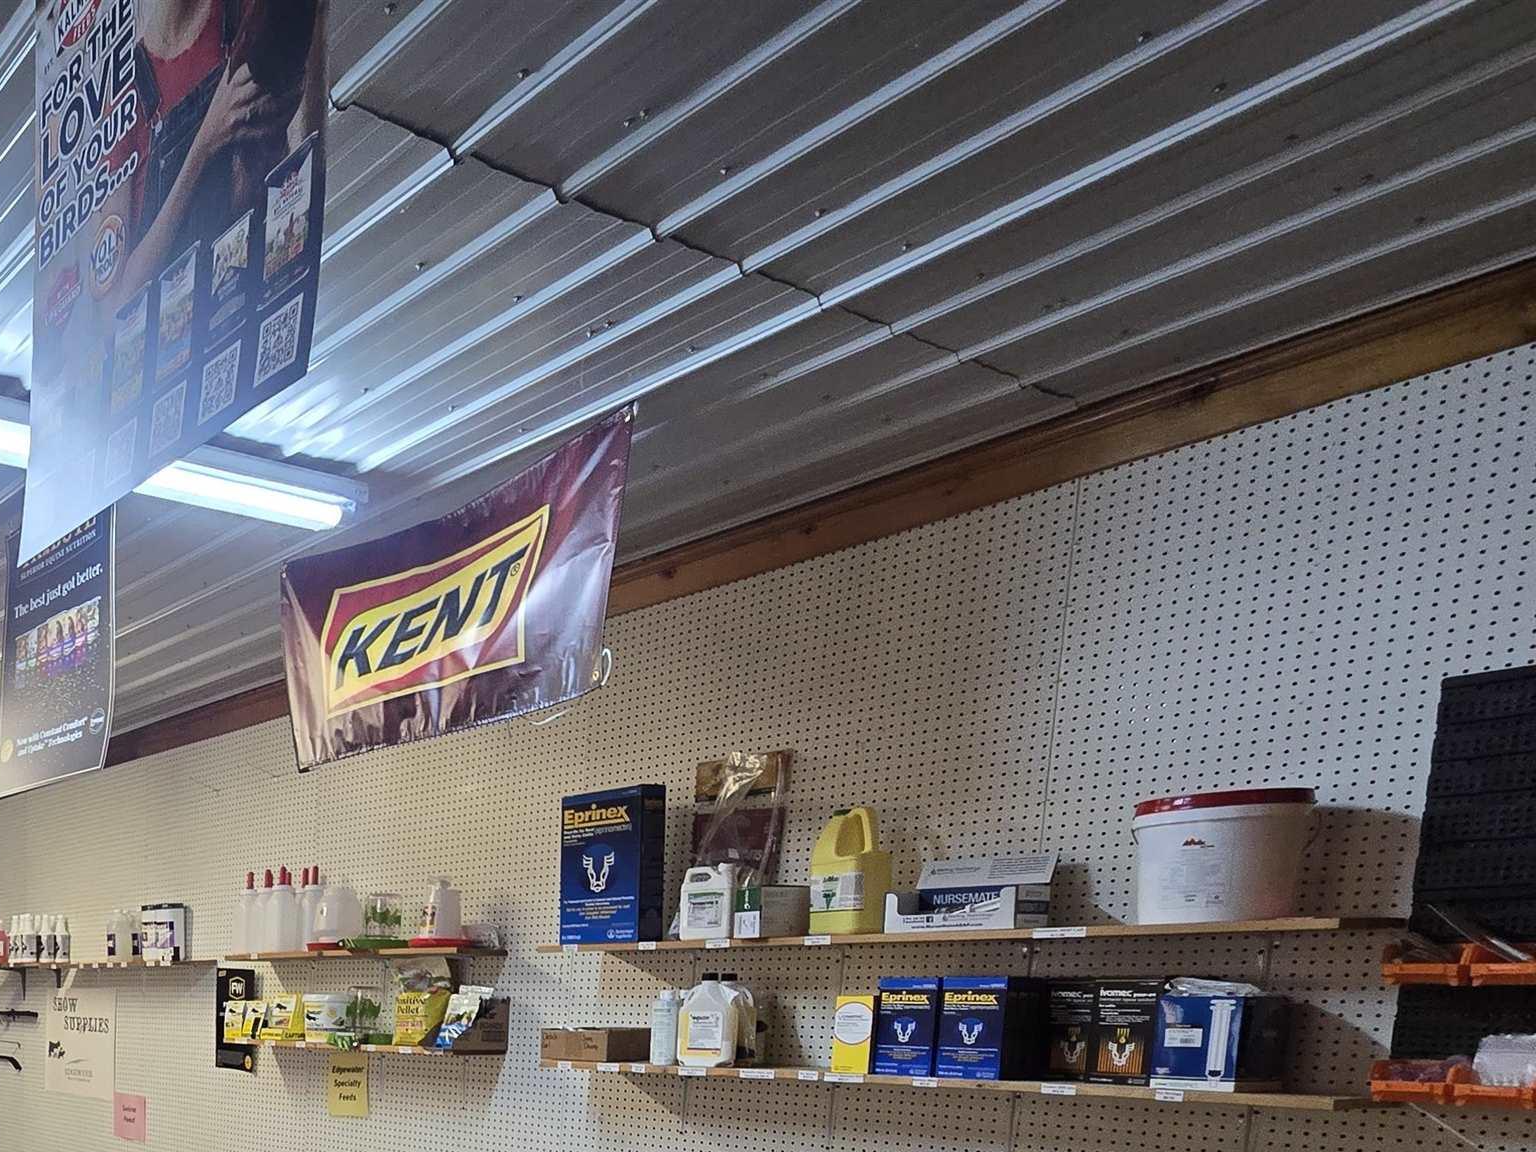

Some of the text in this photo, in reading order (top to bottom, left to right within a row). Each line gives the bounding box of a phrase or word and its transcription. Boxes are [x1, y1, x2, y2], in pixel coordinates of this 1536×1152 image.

[41, 0, 134, 133] FOR THE
[40, 20, 136, 188] LOVE
[39, 168, 68, 226] OF
[71, 89, 137, 189] YOUR
[14, 563, 103, 618] The best just got better.
[335, 542, 531, 690] KENT
[564, 803, 630, 826] Eprinex
[932, 890, 999, 906] NURSEMATE
[53, 996, 79, 1013] SHOW
[881, 991, 929, 1004] Eprinex
[944, 991, 998, 1005] Eprinex
[64, 1015, 110, 1034] SUPPLIES
[334, 1079, 361, 1088] Specialty
[339, 1092, 357, 1101] Feeds
